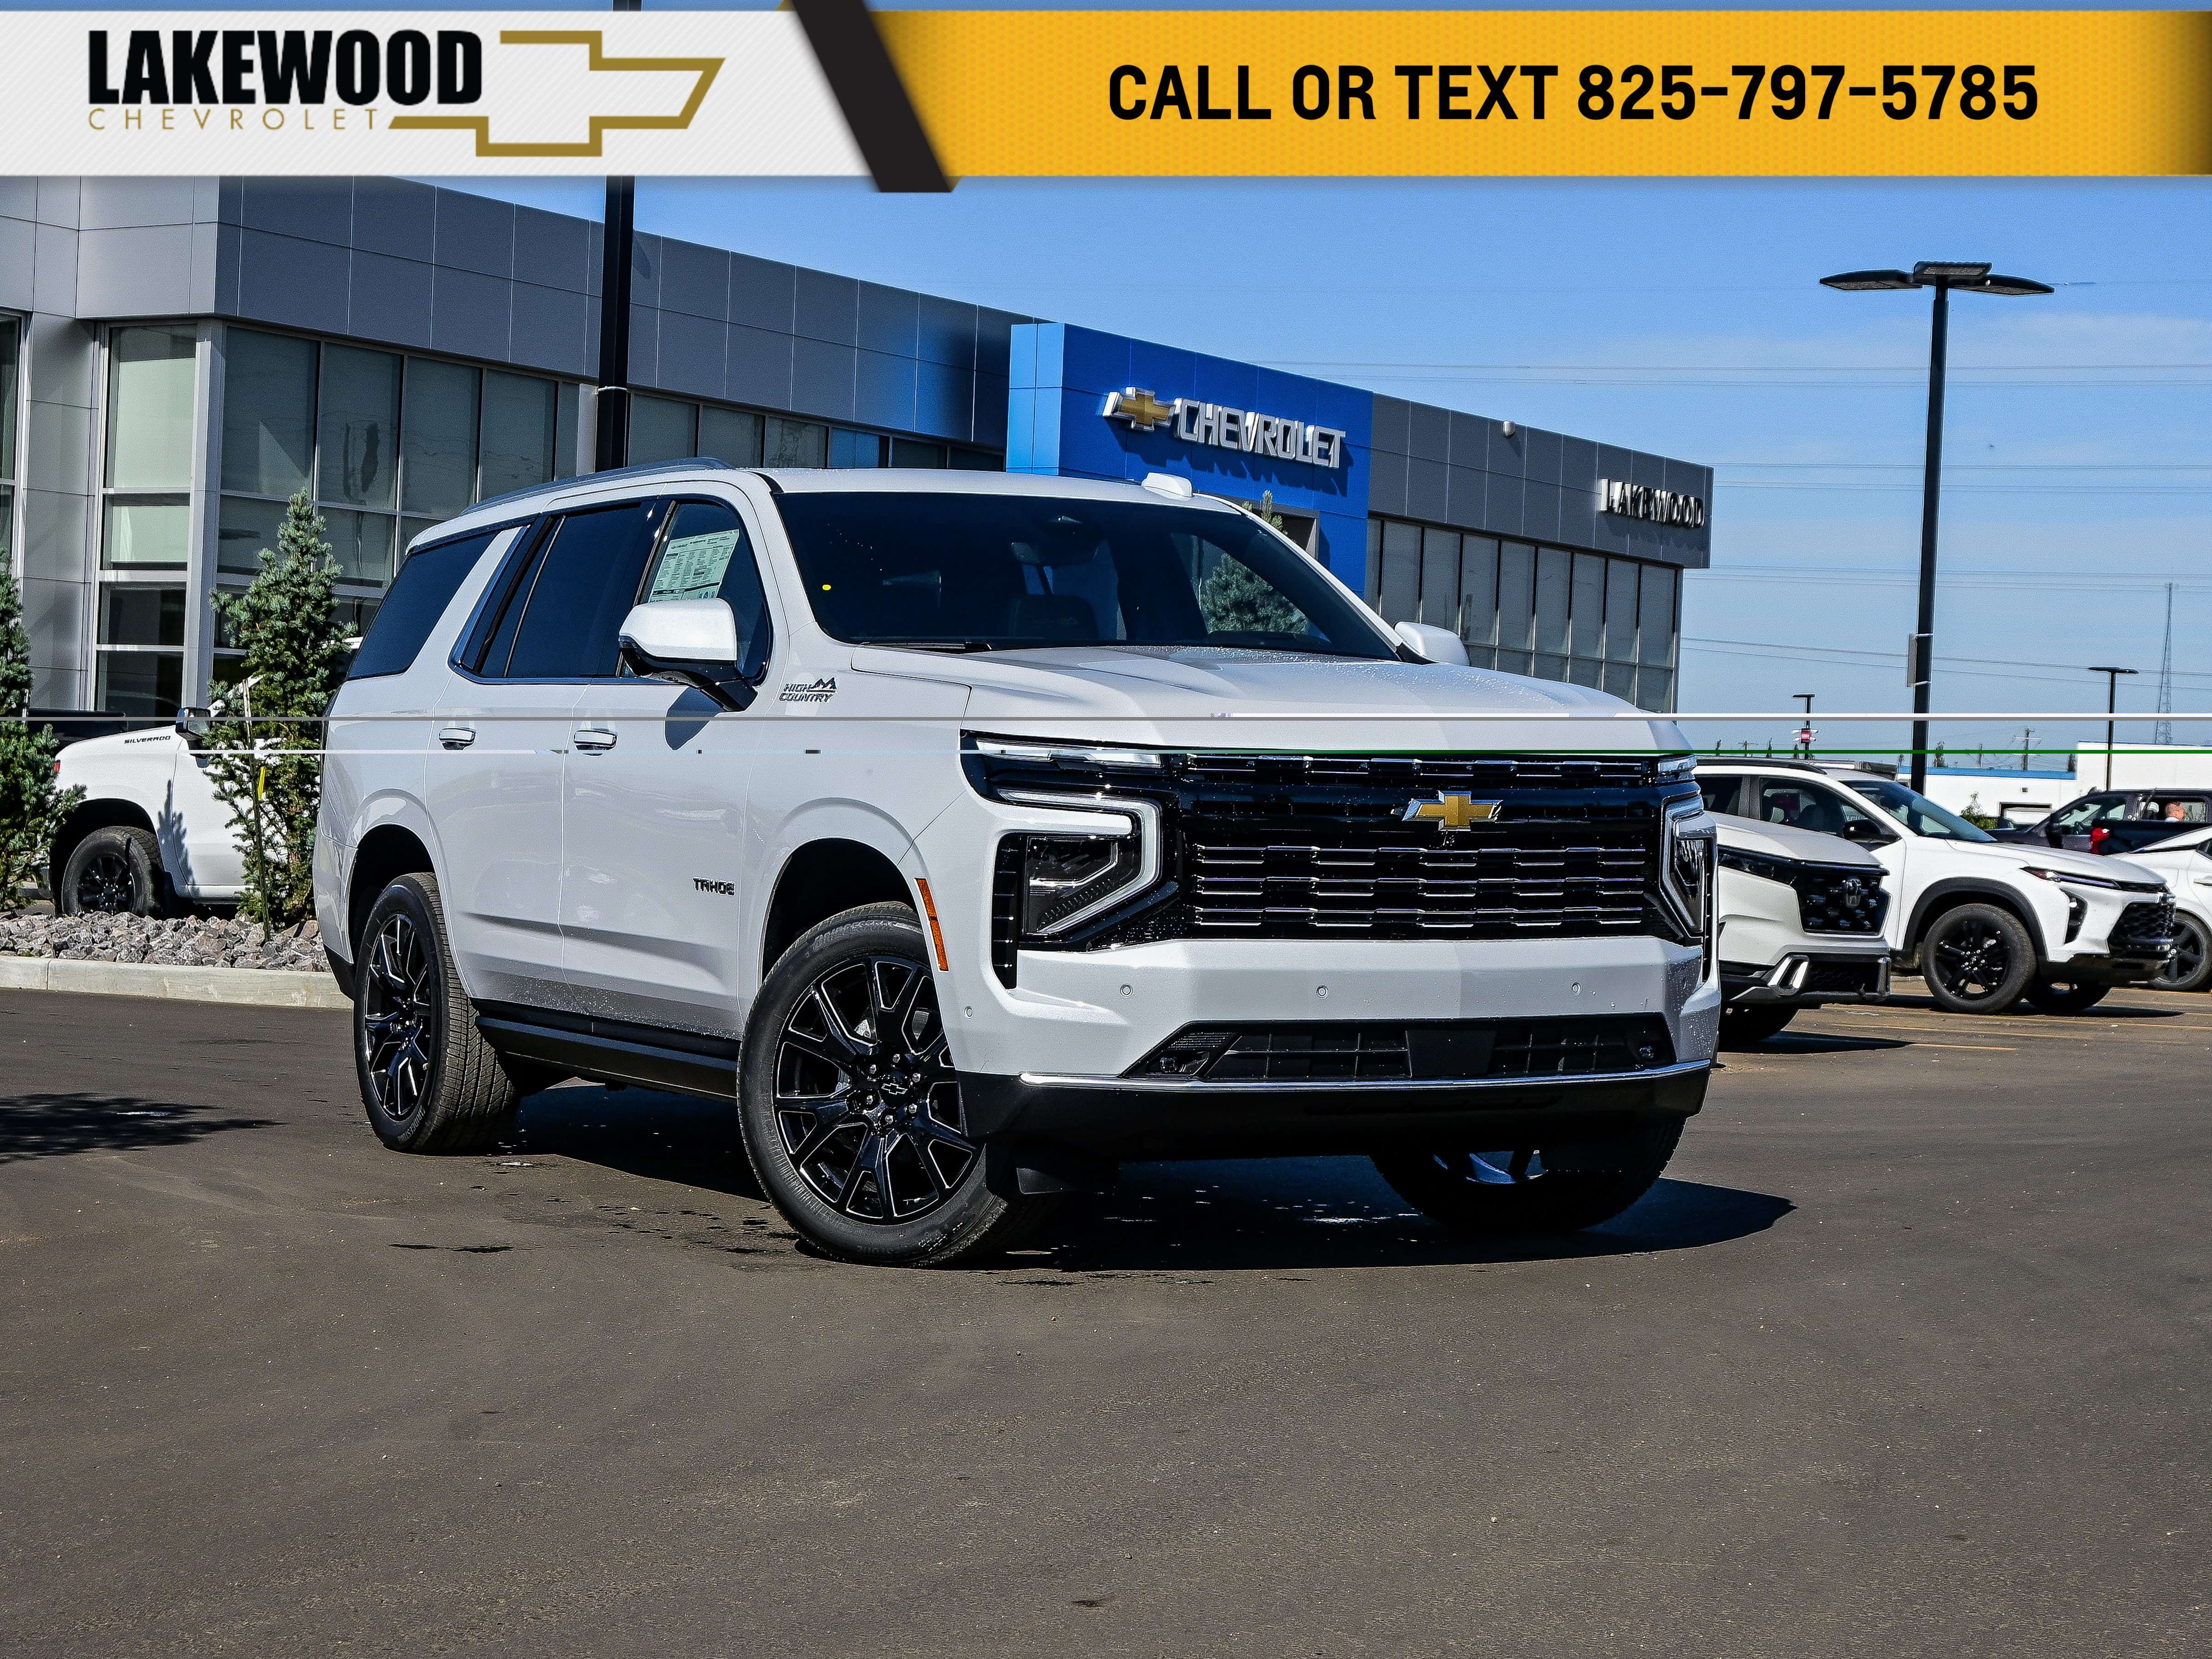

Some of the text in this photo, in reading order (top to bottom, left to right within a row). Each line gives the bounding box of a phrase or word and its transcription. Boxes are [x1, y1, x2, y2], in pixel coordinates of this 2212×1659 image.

[1174, 397, 1346, 469] CHEVROLET
[1599, 479, 1704, 527] LAKEWOOD
[784, 683, 812, 692] HIGH
[779, 692, 834, 702] COUNTRY
[124, 735, 171, 744] SILVERADO
[692, 877, 735, 896] TAHOE
